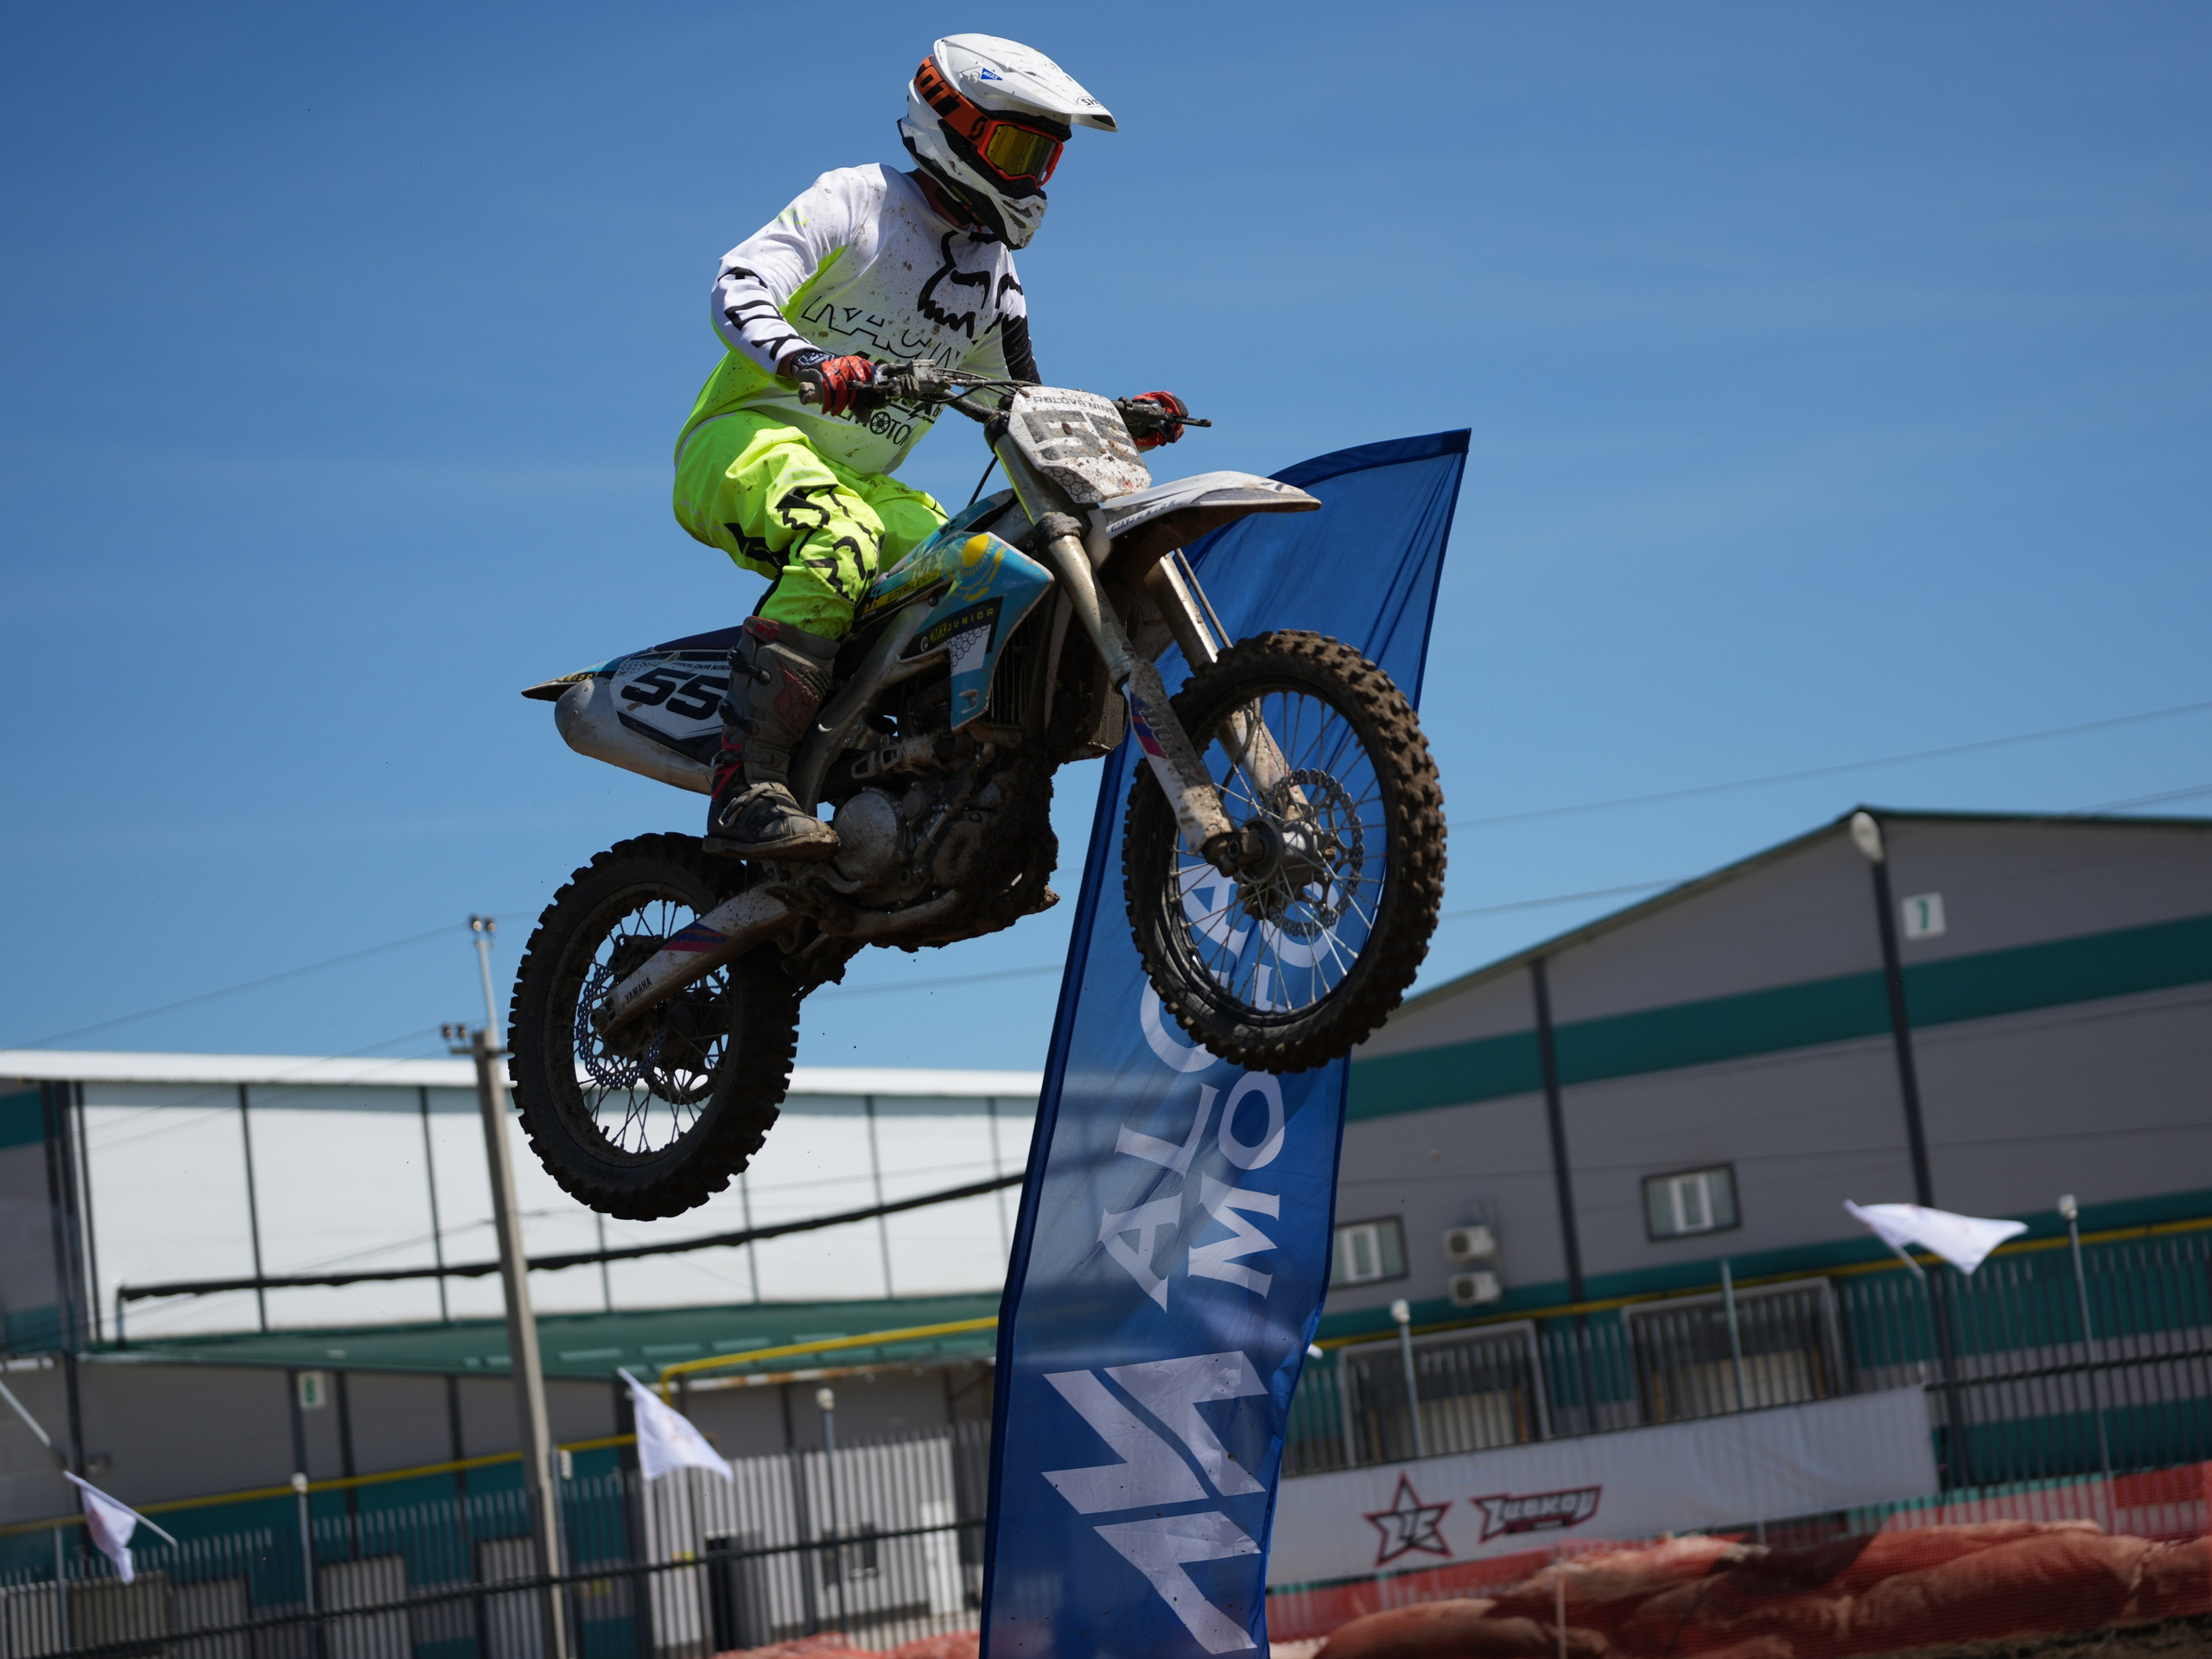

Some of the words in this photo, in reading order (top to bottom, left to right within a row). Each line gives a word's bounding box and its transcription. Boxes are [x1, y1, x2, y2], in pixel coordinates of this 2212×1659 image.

[947, 607, 995, 632] JUNIOR
[671, 661, 711, 671] FROLOVA
[620, 667, 730, 721] 55
[625, 976, 652, 1004] YAMAHA
